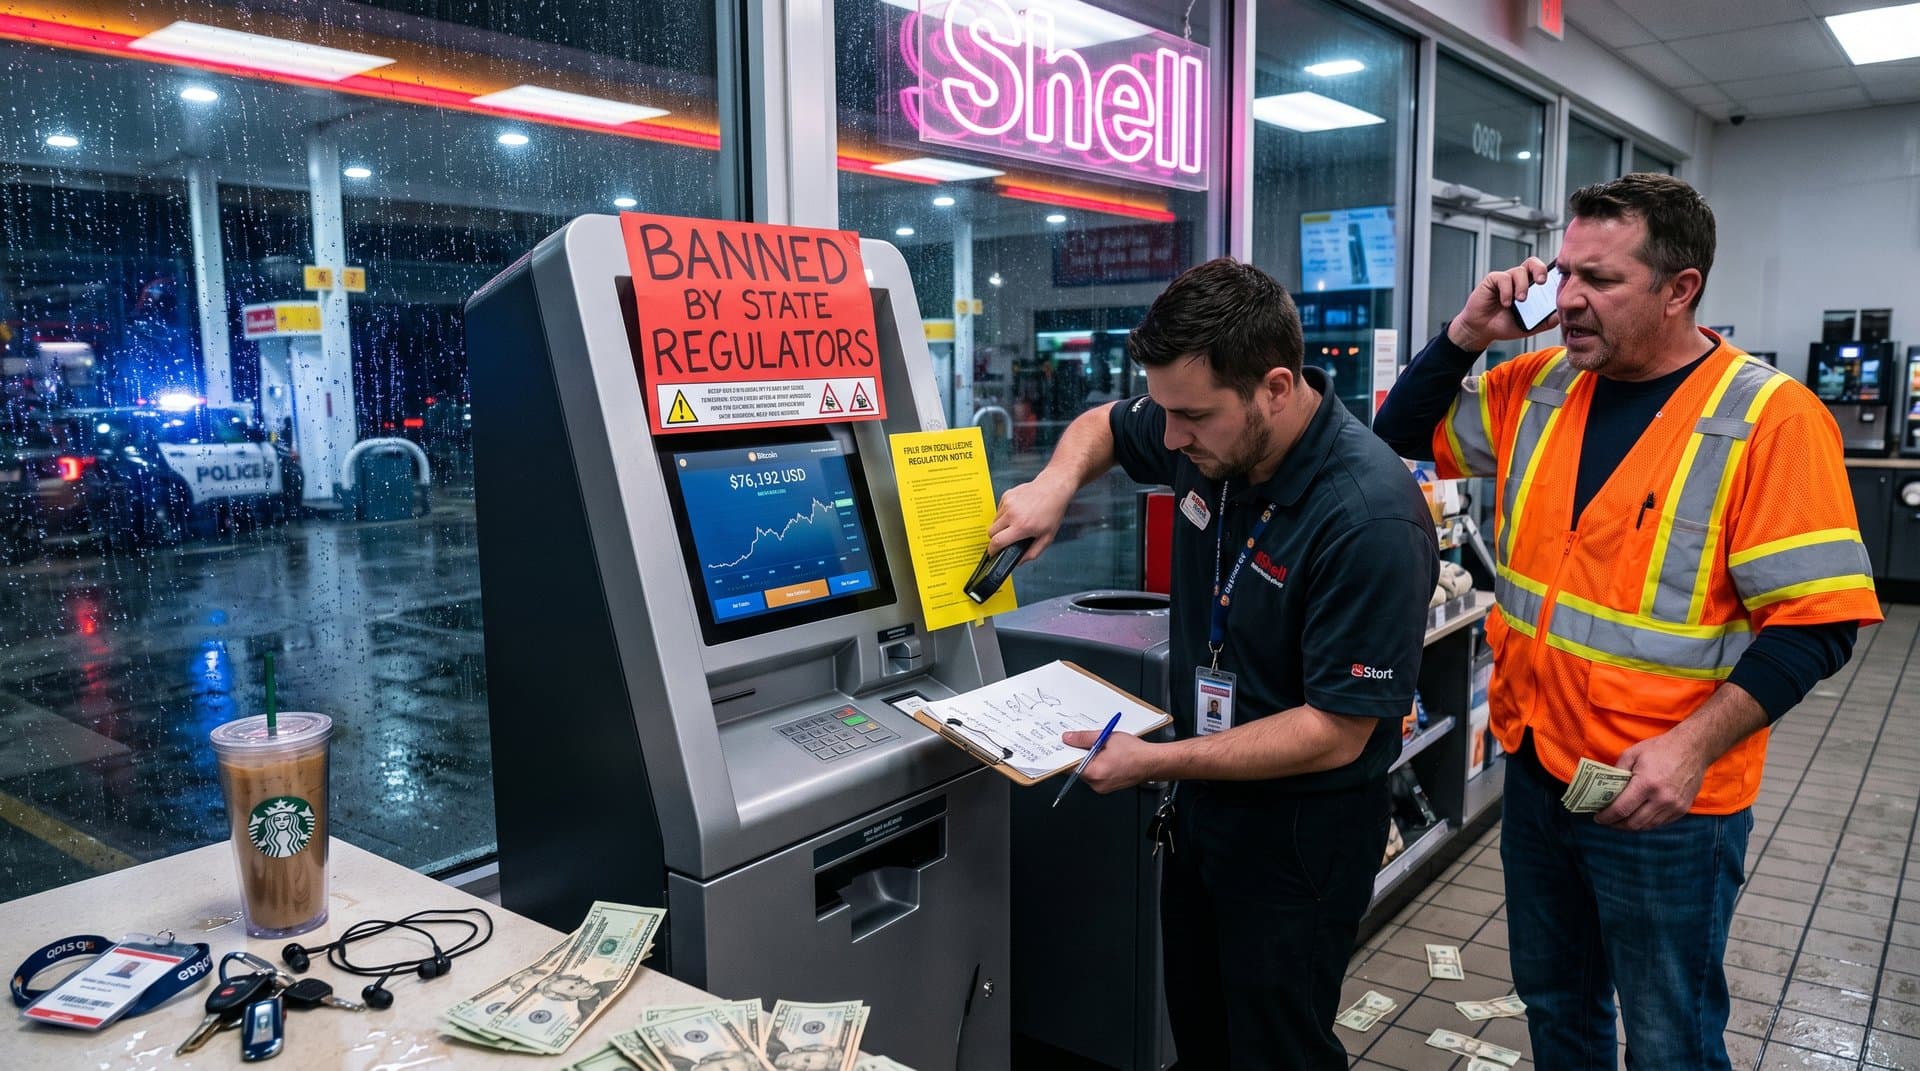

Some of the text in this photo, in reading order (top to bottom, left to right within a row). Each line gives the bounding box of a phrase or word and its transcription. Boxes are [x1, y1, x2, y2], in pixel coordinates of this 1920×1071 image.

[942, 0, 1202, 174] Shell
[640, 223, 848, 284] BANNED
[684, 288, 832, 320] BY STATE
[653, 328, 874, 375] REGULATORS
[908, 451, 974, 466] REGULATION NOTICE
[197, 463, 261, 483] POLICE
[729, 468, 806, 490] $76,192 USD
[1364, 667, 1393, 679] Stort
